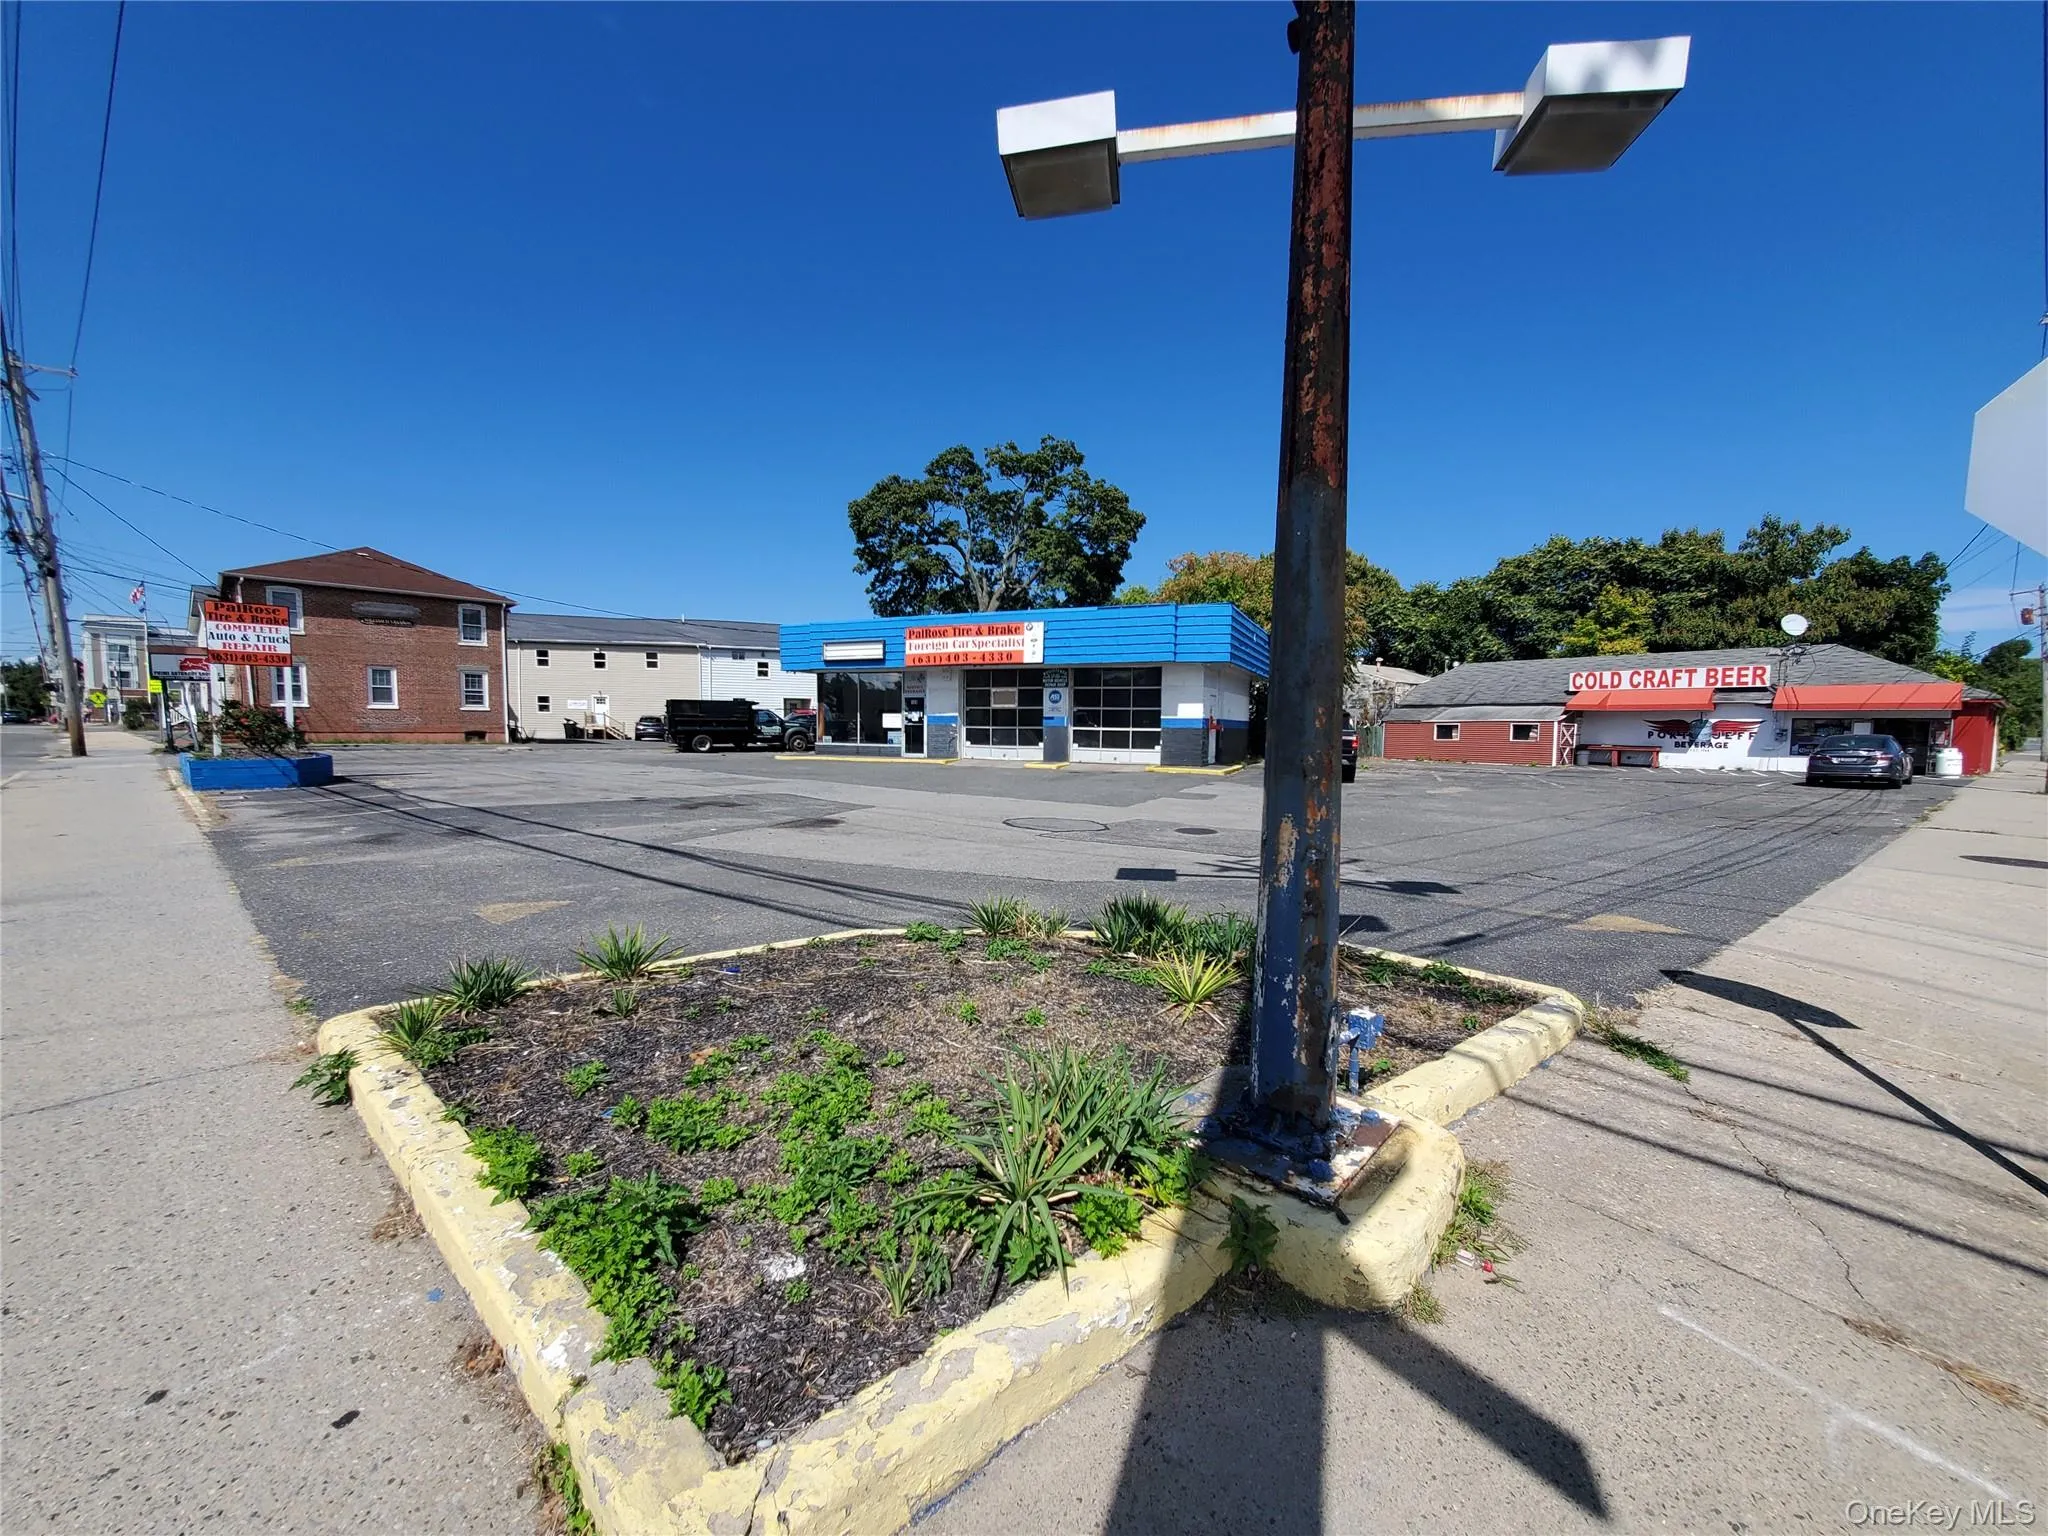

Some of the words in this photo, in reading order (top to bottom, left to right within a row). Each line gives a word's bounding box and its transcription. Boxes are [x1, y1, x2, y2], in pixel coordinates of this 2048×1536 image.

[214, 602, 281, 616] PalRose
[208, 612, 232, 621] Tire
[237, 615, 247, 623] &
[251, 615, 288, 626] Brake
[215, 623, 282, 634] COMPLETE
[908, 627, 949, 639] PalRose
[952, 626, 972, 637] Tire
[975, 626, 984, 636] &
[987, 624, 1021, 636] Brake
[208, 631, 236, 641] Auto
[241, 633, 250, 642] &
[255, 634, 290, 644] Truck
[908, 639, 949, 652] Foreign
[952, 638, 970, 649] Car
[971, 637, 1024, 650] Specialist
[222, 642, 278, 652] REPAIR
[1572, 671, 1622, 690] COLD
[1629, 668, 1697, 689] CRAFT
[1705, 666, 1767, 687] BEER
[1674, 741, 1729, 749] BEVERAGE
